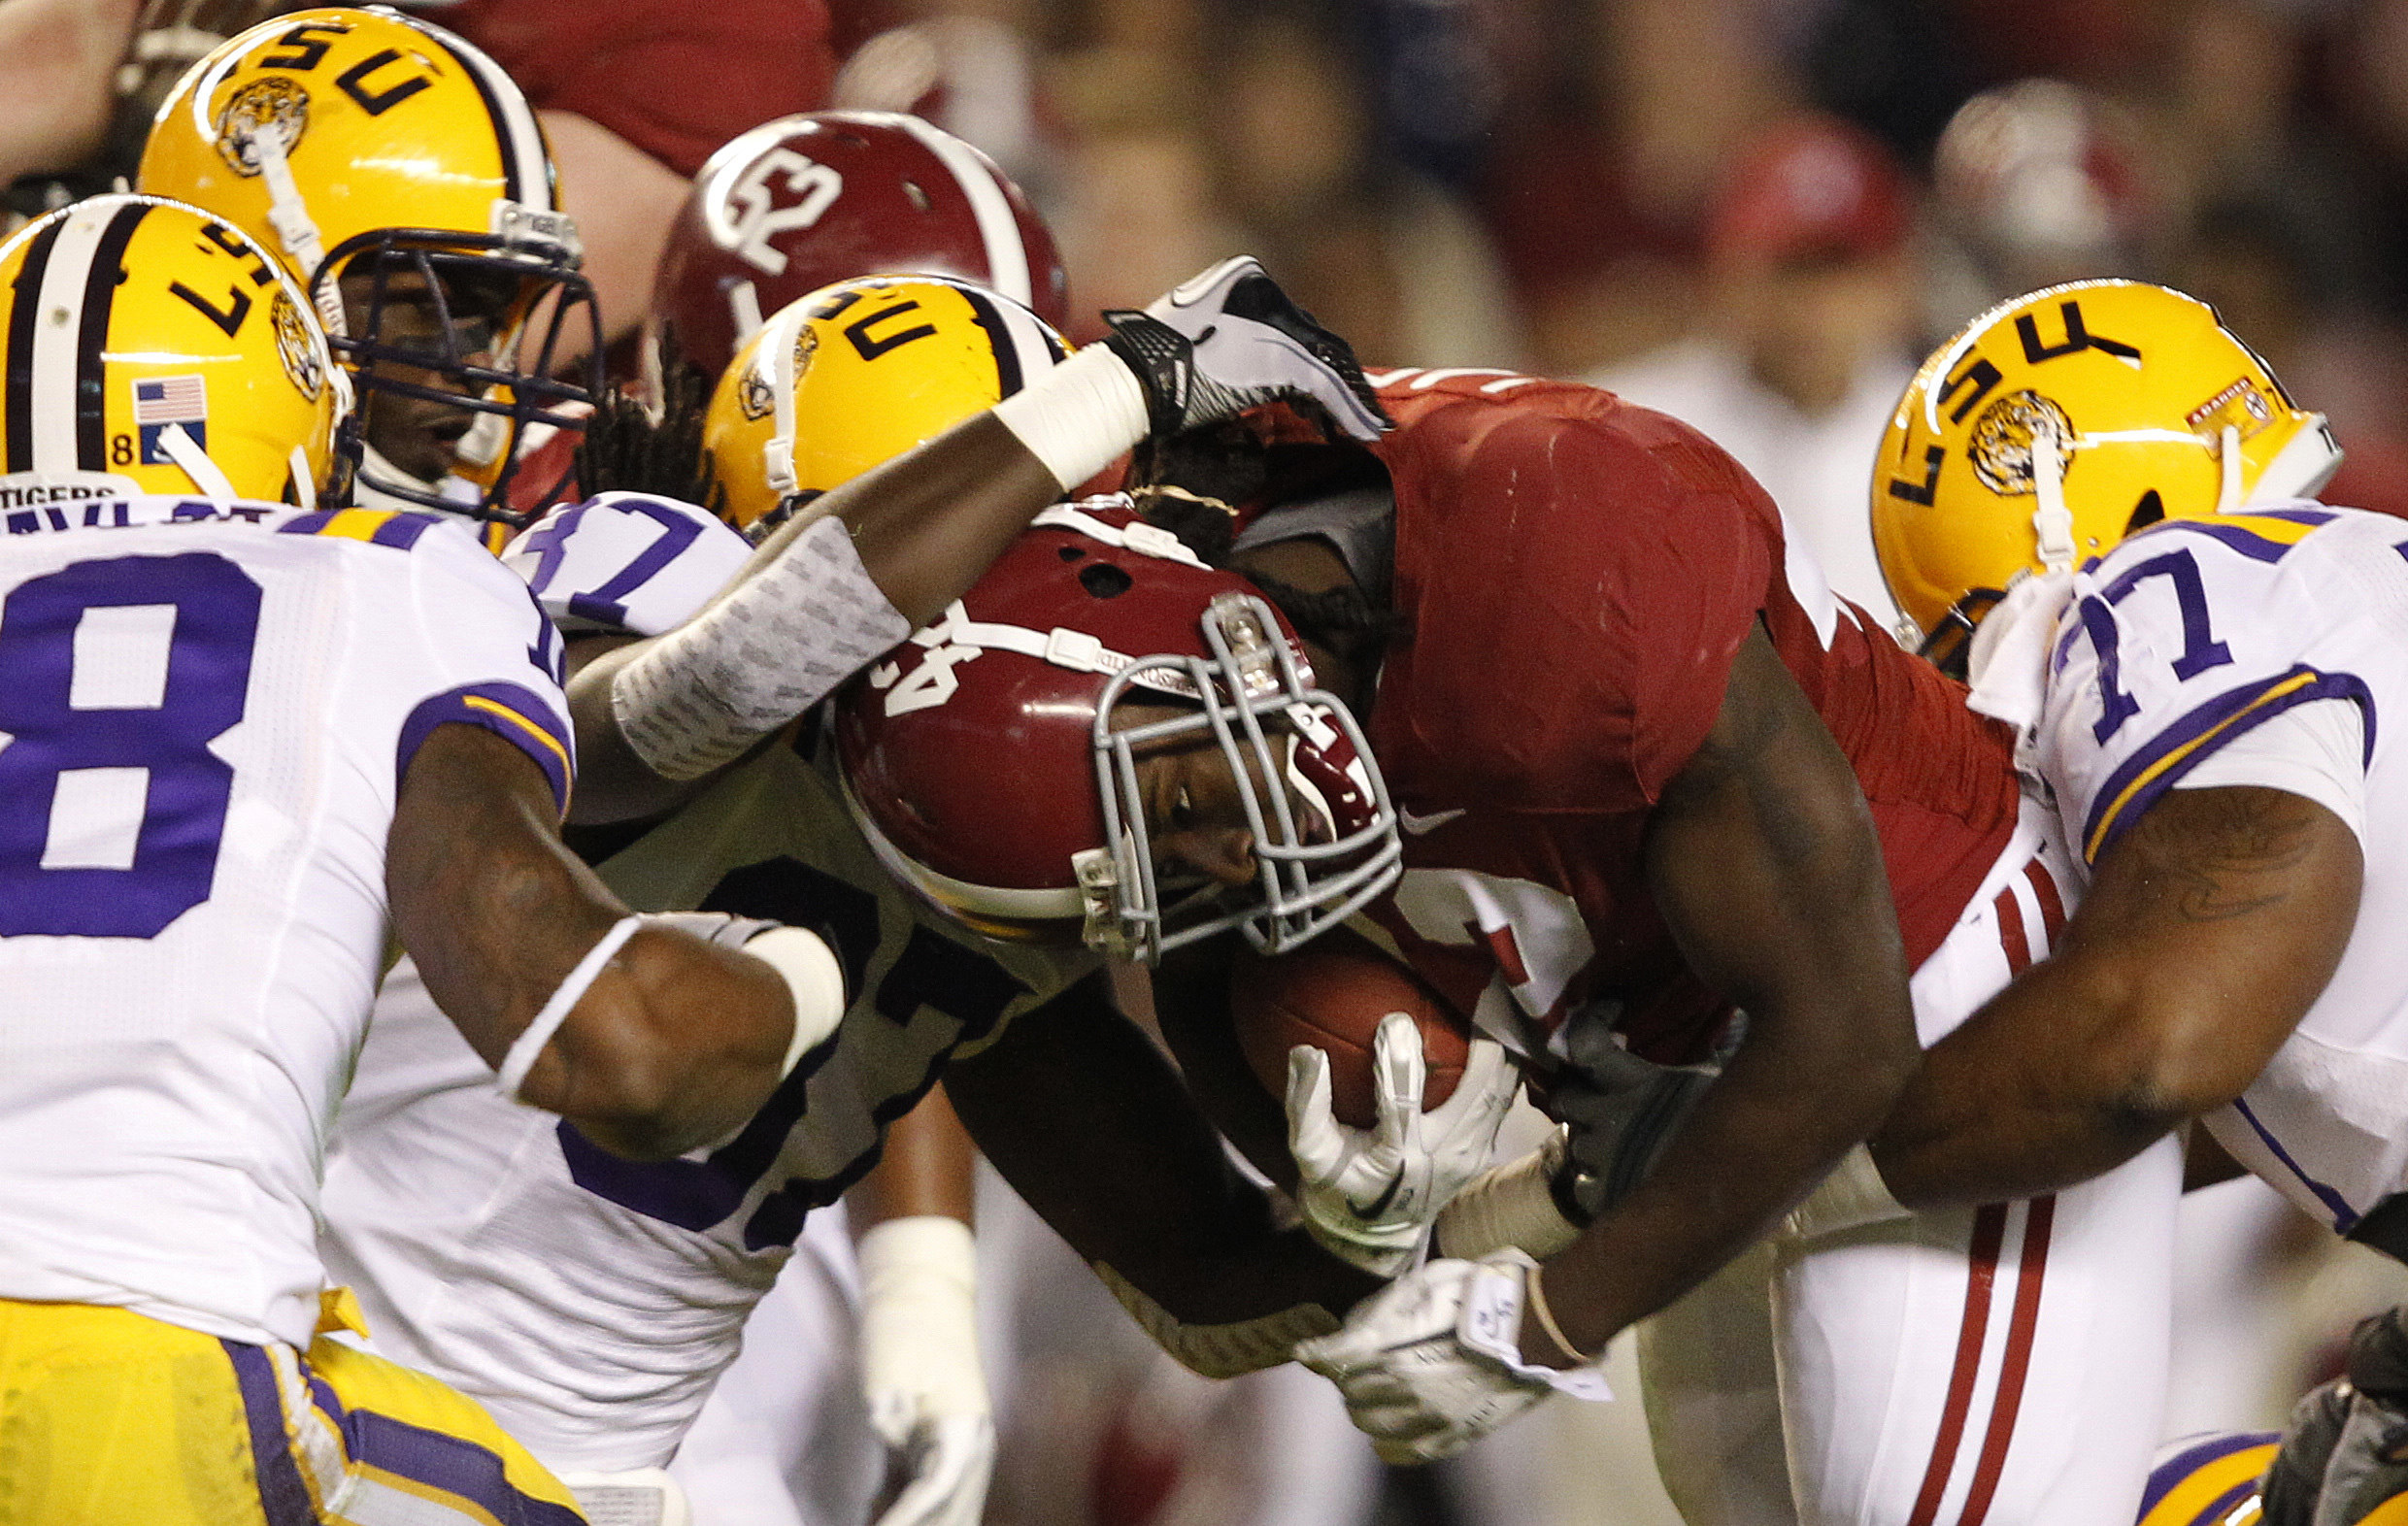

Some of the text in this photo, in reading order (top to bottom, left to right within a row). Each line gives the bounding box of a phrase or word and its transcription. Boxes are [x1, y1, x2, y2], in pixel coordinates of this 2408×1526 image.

[197, 24, 433, 116] SU
[112, 434, 133, 466] 8
[1889, 300, 2141, 507] LSU
[0, 550, 263, 939] 8
